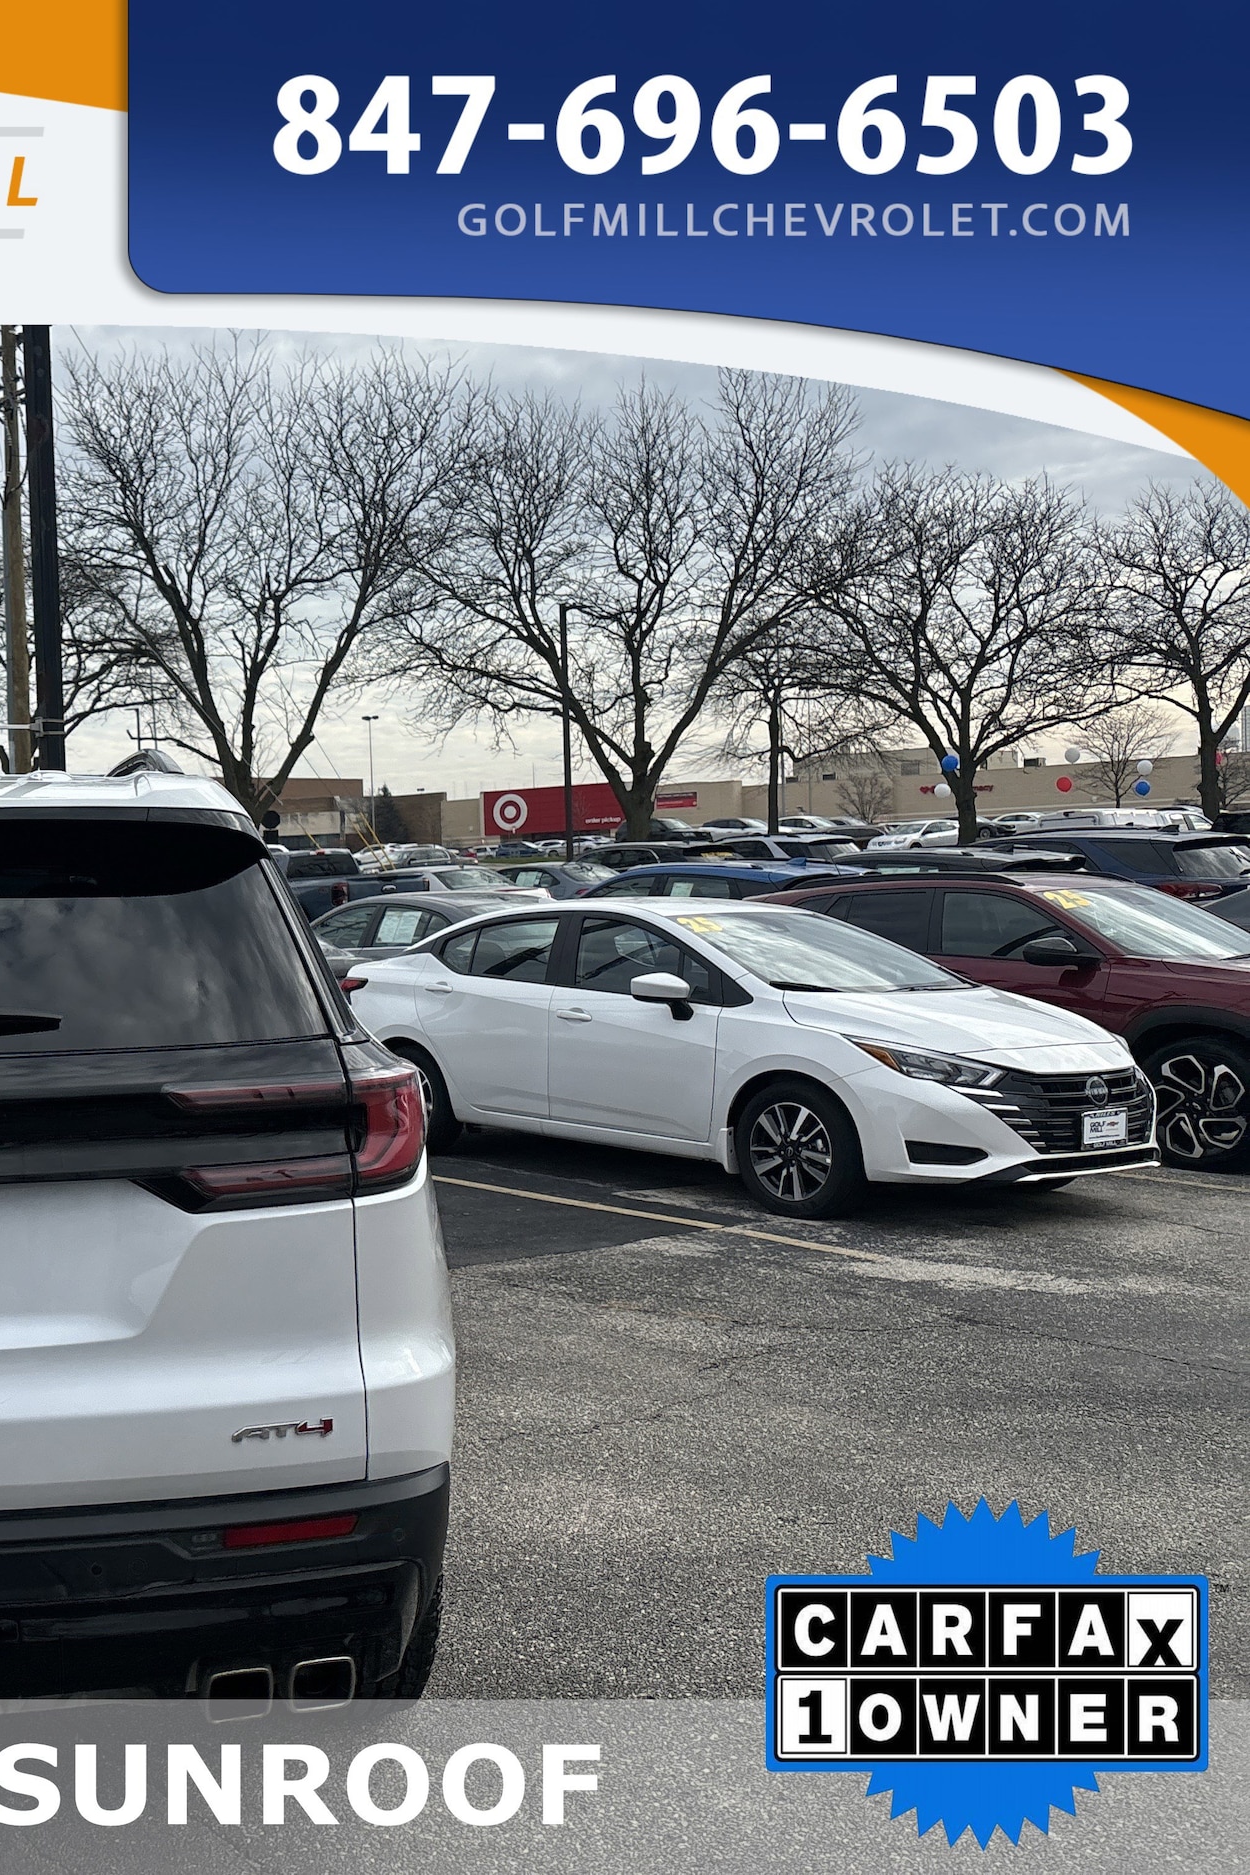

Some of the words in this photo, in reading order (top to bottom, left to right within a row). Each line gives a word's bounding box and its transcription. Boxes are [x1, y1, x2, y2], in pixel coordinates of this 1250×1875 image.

[1043, 890, 1090, 909] 25
[676, 917, 723, 932] 25
[231, 1416, 333, 1443] AT4
